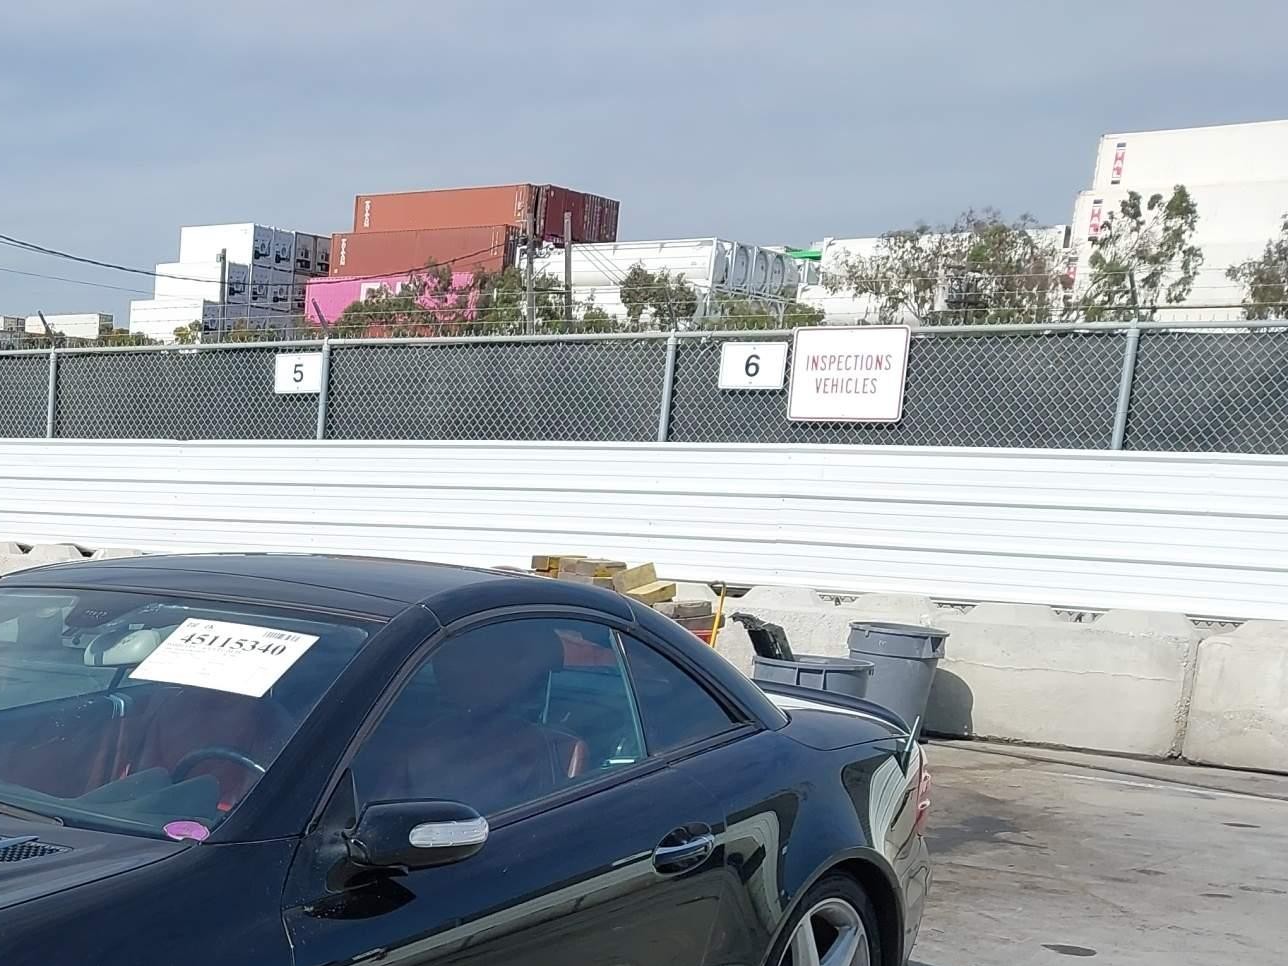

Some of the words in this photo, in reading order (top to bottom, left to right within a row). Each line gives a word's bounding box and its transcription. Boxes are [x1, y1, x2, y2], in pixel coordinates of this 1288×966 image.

[293, 363, 304, 383] 5
[744, 354, 760, 377] 6
[806, 354, 892, 372] INSPECTIONS
[815, 377, 878, 395] VEHICLES
[180, 632, 287, 656] 45115340
